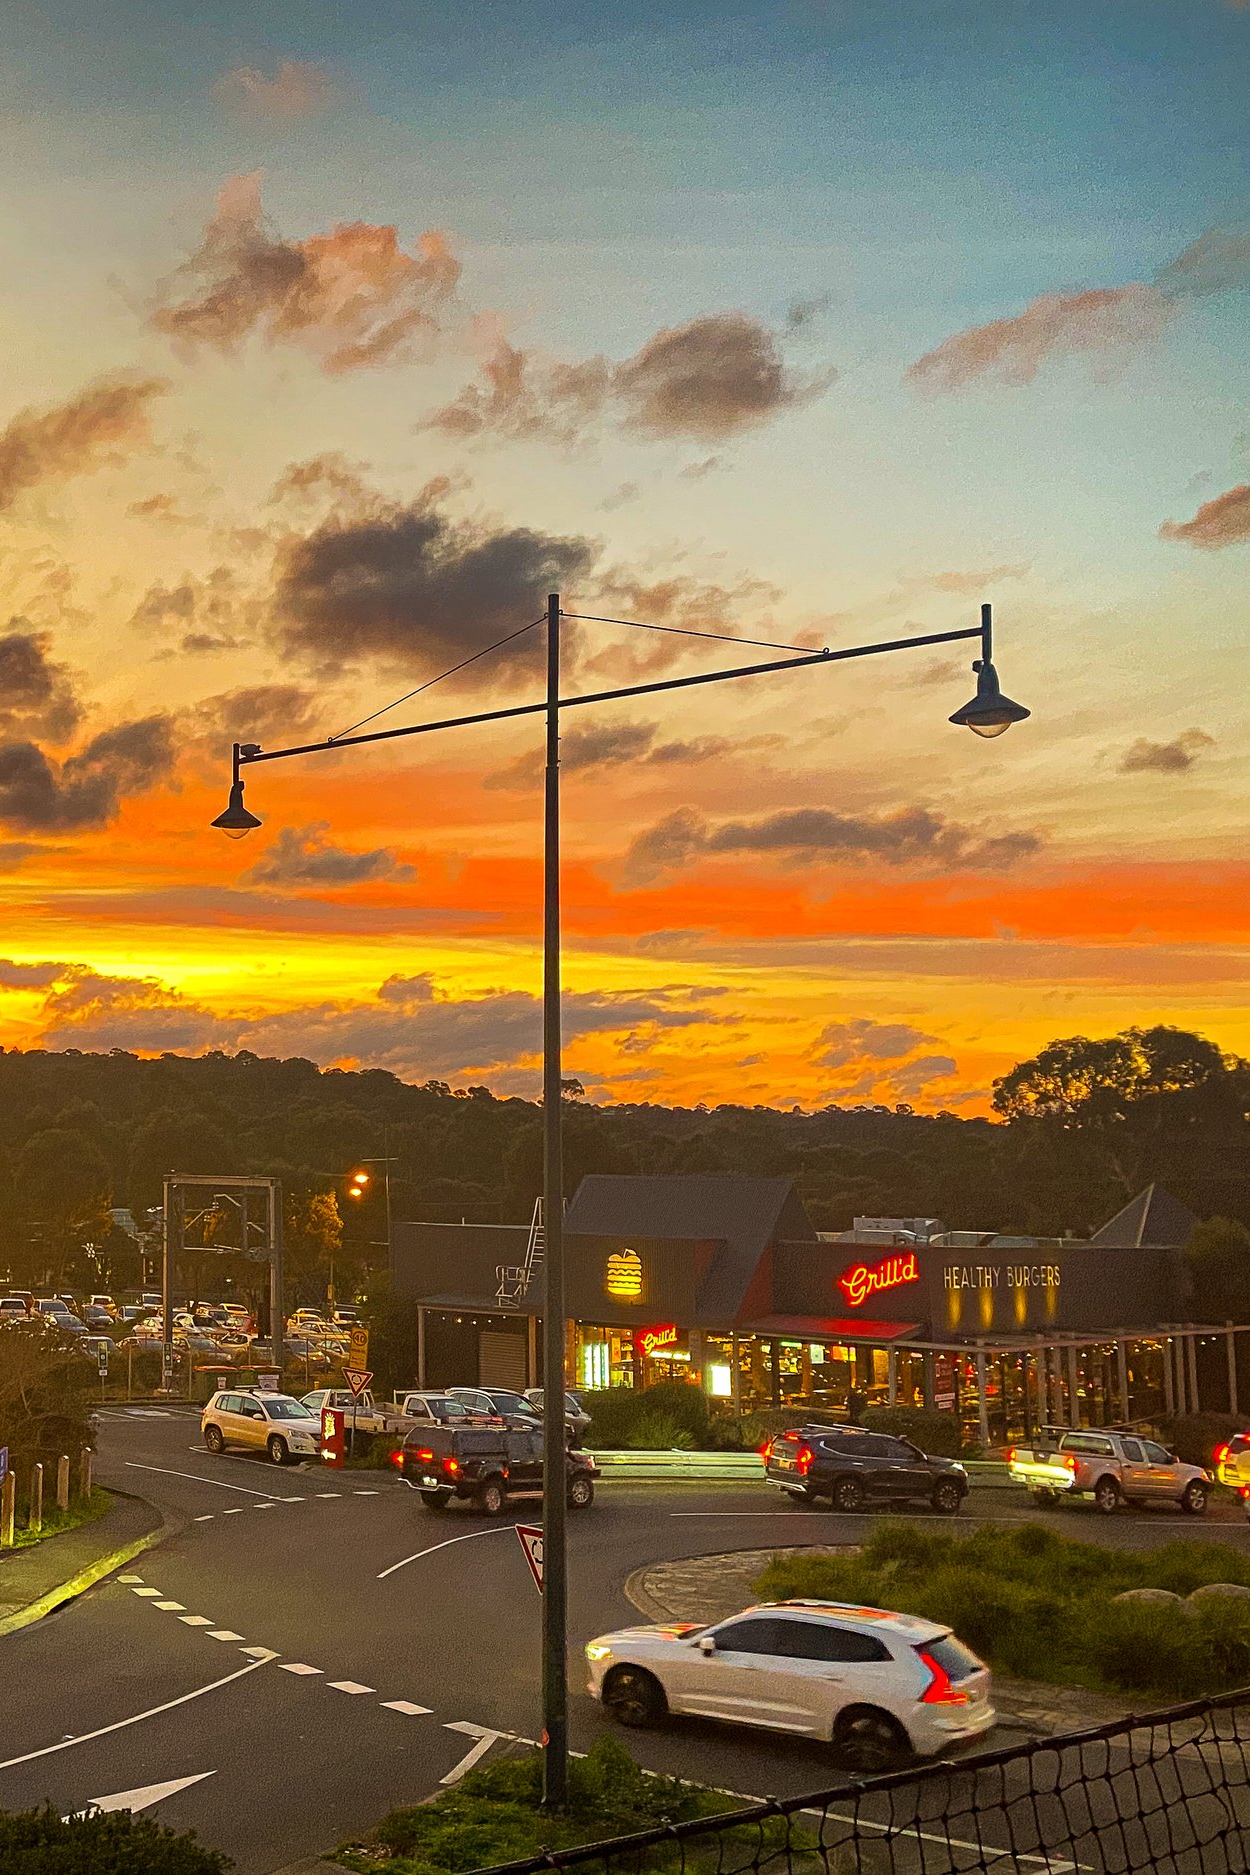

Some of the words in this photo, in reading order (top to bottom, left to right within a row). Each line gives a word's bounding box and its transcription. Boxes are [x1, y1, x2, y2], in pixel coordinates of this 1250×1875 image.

[841, 1253, 918, 1304] Grill'd
[943, 1266, 1000, 1289] HEALTHY
[1007, 1265, 1061, 1287] BURGERS
[640, 1327, 678, 1354] Grill'd
